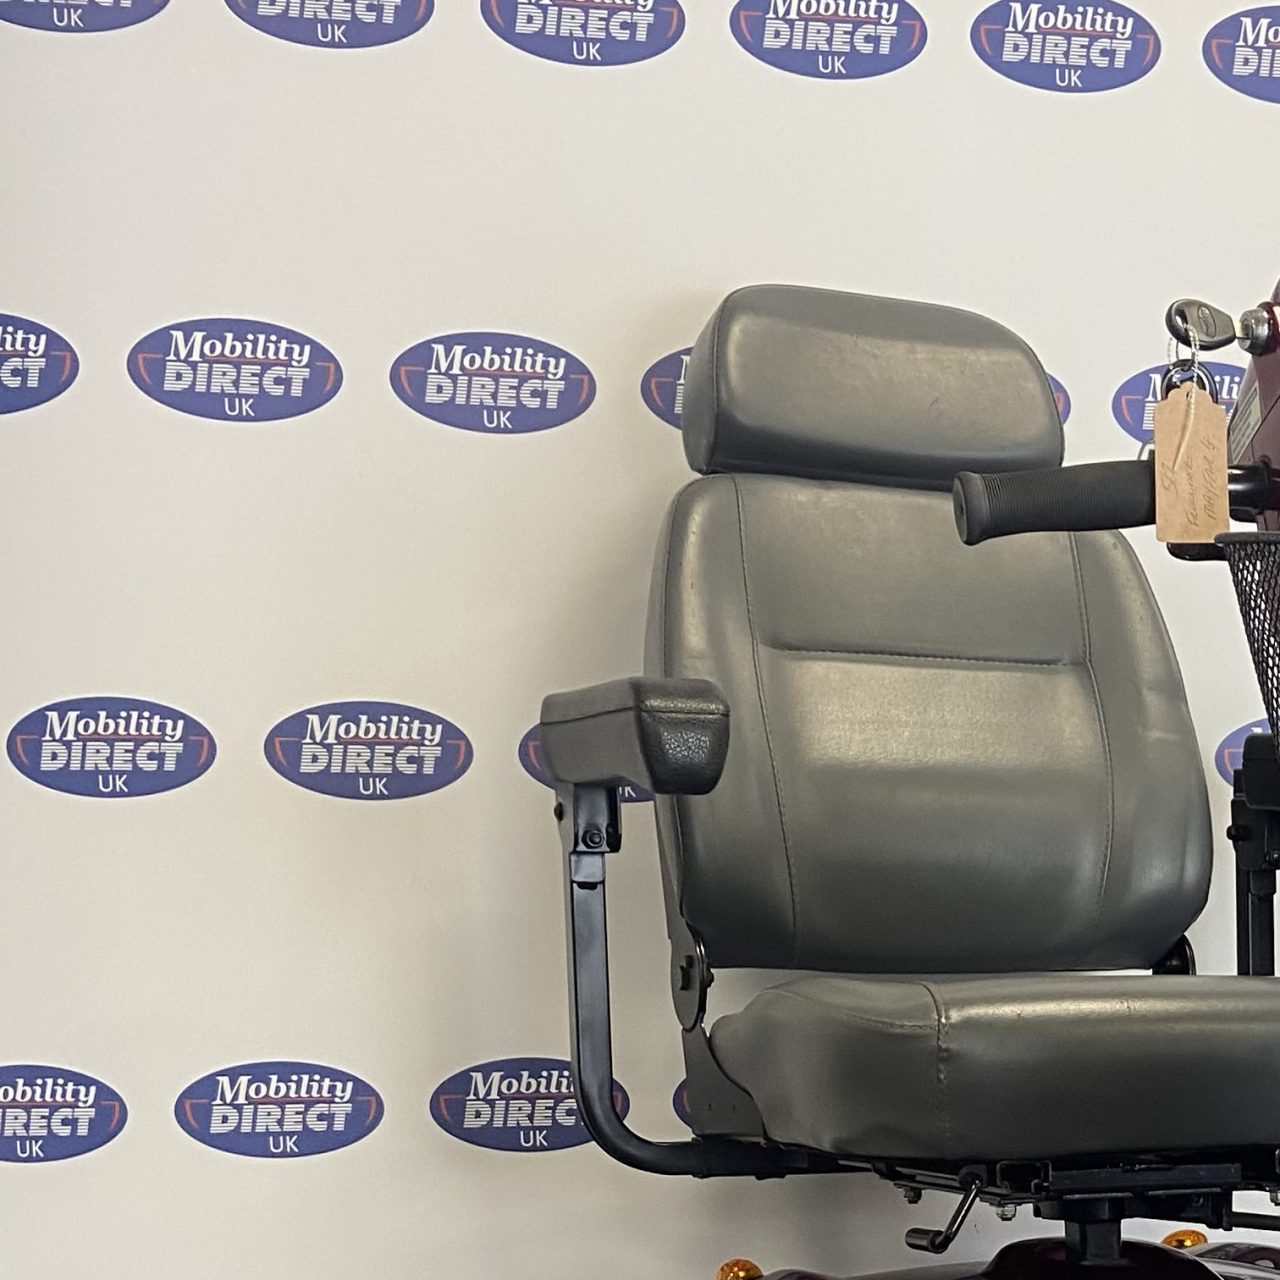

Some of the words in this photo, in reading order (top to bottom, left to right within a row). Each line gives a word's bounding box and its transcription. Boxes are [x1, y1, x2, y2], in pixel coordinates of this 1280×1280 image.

[53, 8, 83, 27] UK
[515, 4, 655, 42] DIRECT
[1005, 2, 1134, 38] Mobility
[317, 23, 347, 43] UK
[763, 19, 897, 54] DIRECT
[573, 41, 601, 60] UK
[819, 54, 846, 74] UK
[1002, 33, 1132, 68] DIRECT
[1056, 68, 1082, 87] UK
[166, 330, 310, 367] Mobility
[428, 343, 565, 379] Mobility
[164, 362, 310, 397] DIRECT
[425, 374, 565, 409] DIRECT
[224, 397, 254, 417] UK
[483, 409, 512, 429] UK
[42, 711, 184, 742] Mobility
[302, 714, 443, 745] Mobility
[40, 742, 184, 771] DIRECT
[300, 745, 442, 774] DIRECT
[99, 774, 128, 792] UK
[359, 777, 388, 795] UK
[0, 1078, 96, 1108] obility
[211, 1074, 353, 1104] Mobility
[210, 1103, 353, 1133] DIRECT
[464, 1099, 577, 1128] DIREC
[17, 1140, 44, 1157] UK
[269, 1135, 299, 1153] UK
[520, 1130, 548, 1147] UK
